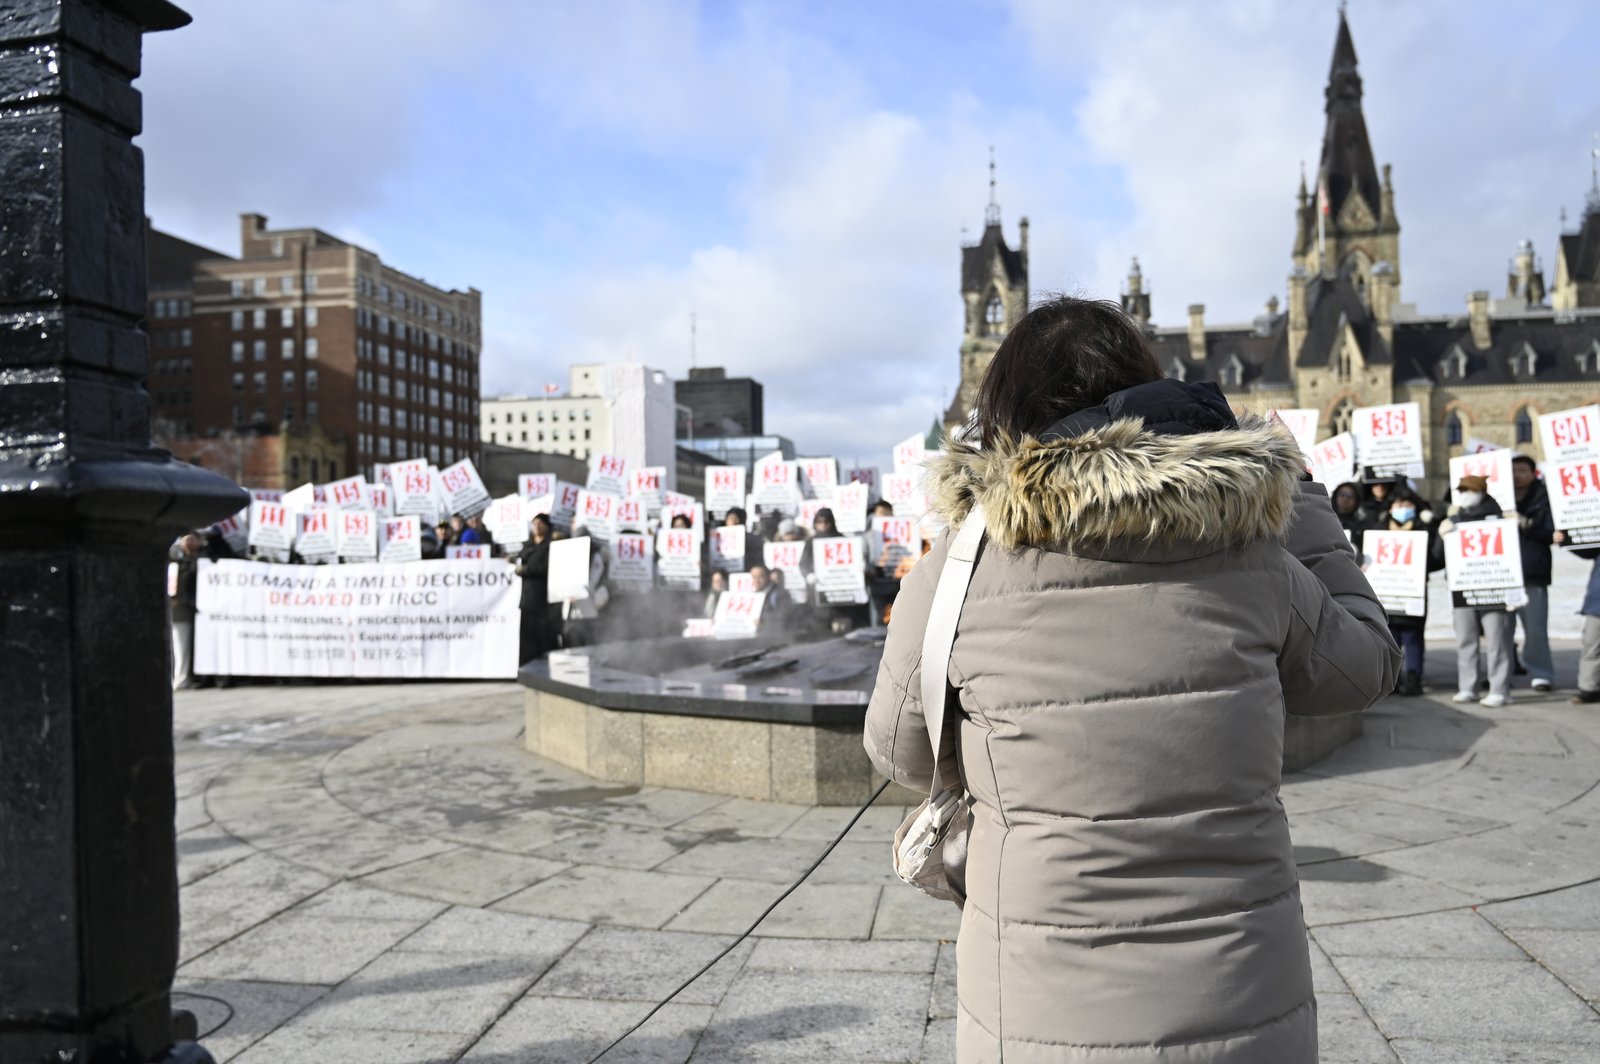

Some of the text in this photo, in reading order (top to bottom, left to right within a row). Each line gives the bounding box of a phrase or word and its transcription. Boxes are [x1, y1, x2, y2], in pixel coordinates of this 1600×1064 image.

[1372, 409, 1407, 437] 36
[1552, 415, 1590, 446] 90
[1559, 463, 1600, 496] 31
[1376, 537, 1414, 566] 37
[1459, 526, 1504, 558] 37
[326, 577, 338, 589] A
[416, 571, 514, 588] DECISION
[269, 591, 438, 606] DELAYED BY IRCC
[358, 614, 442, 625] PROCEDURAL
